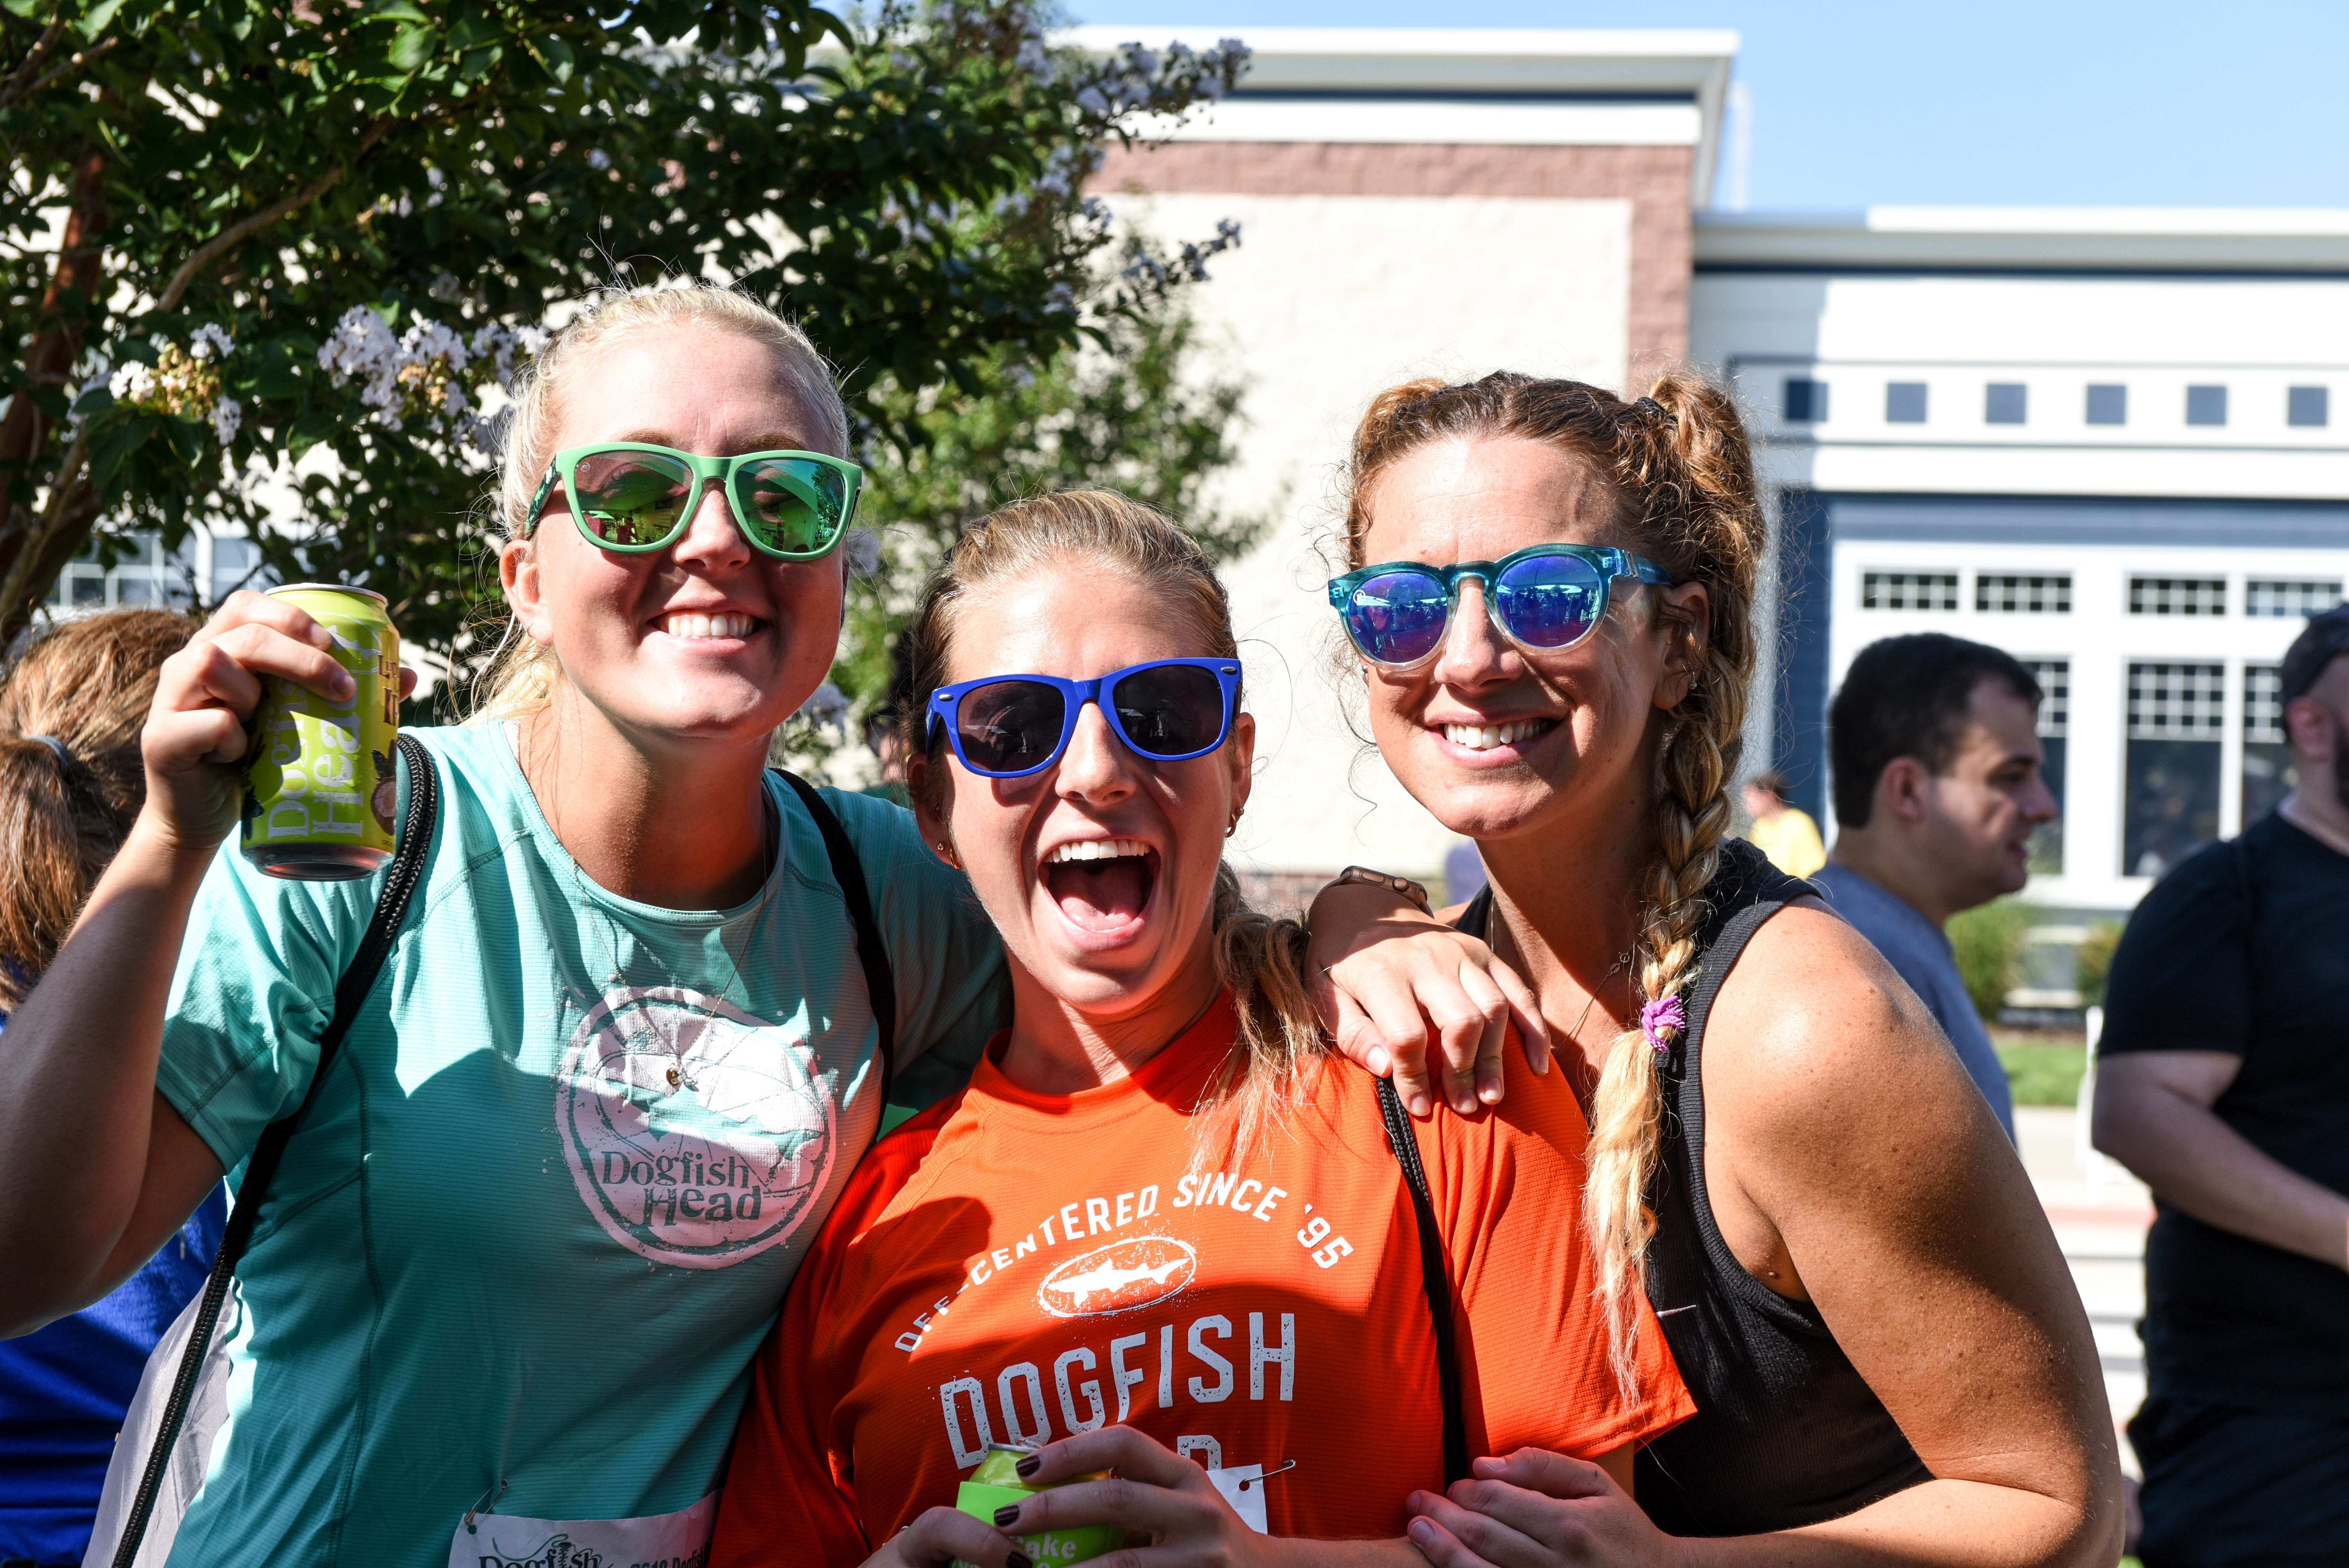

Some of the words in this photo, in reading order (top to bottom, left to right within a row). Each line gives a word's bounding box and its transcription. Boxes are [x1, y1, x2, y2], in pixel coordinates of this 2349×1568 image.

[267, 677, 309, 839] Dogfis
[601, 1151, 749, 1189] Dogfish
[642, 1185, 761, 1227] Head
[895, 1185, 1158, 1352] OFF-CENTERED
[1173, 1172, 1288, 1222] SINCE
[1297, 1203, 1354, 1269] '95
[940, 1312, 1295, 1469] DOGFISH
[1009, 1532, 1077, 1561] ake
